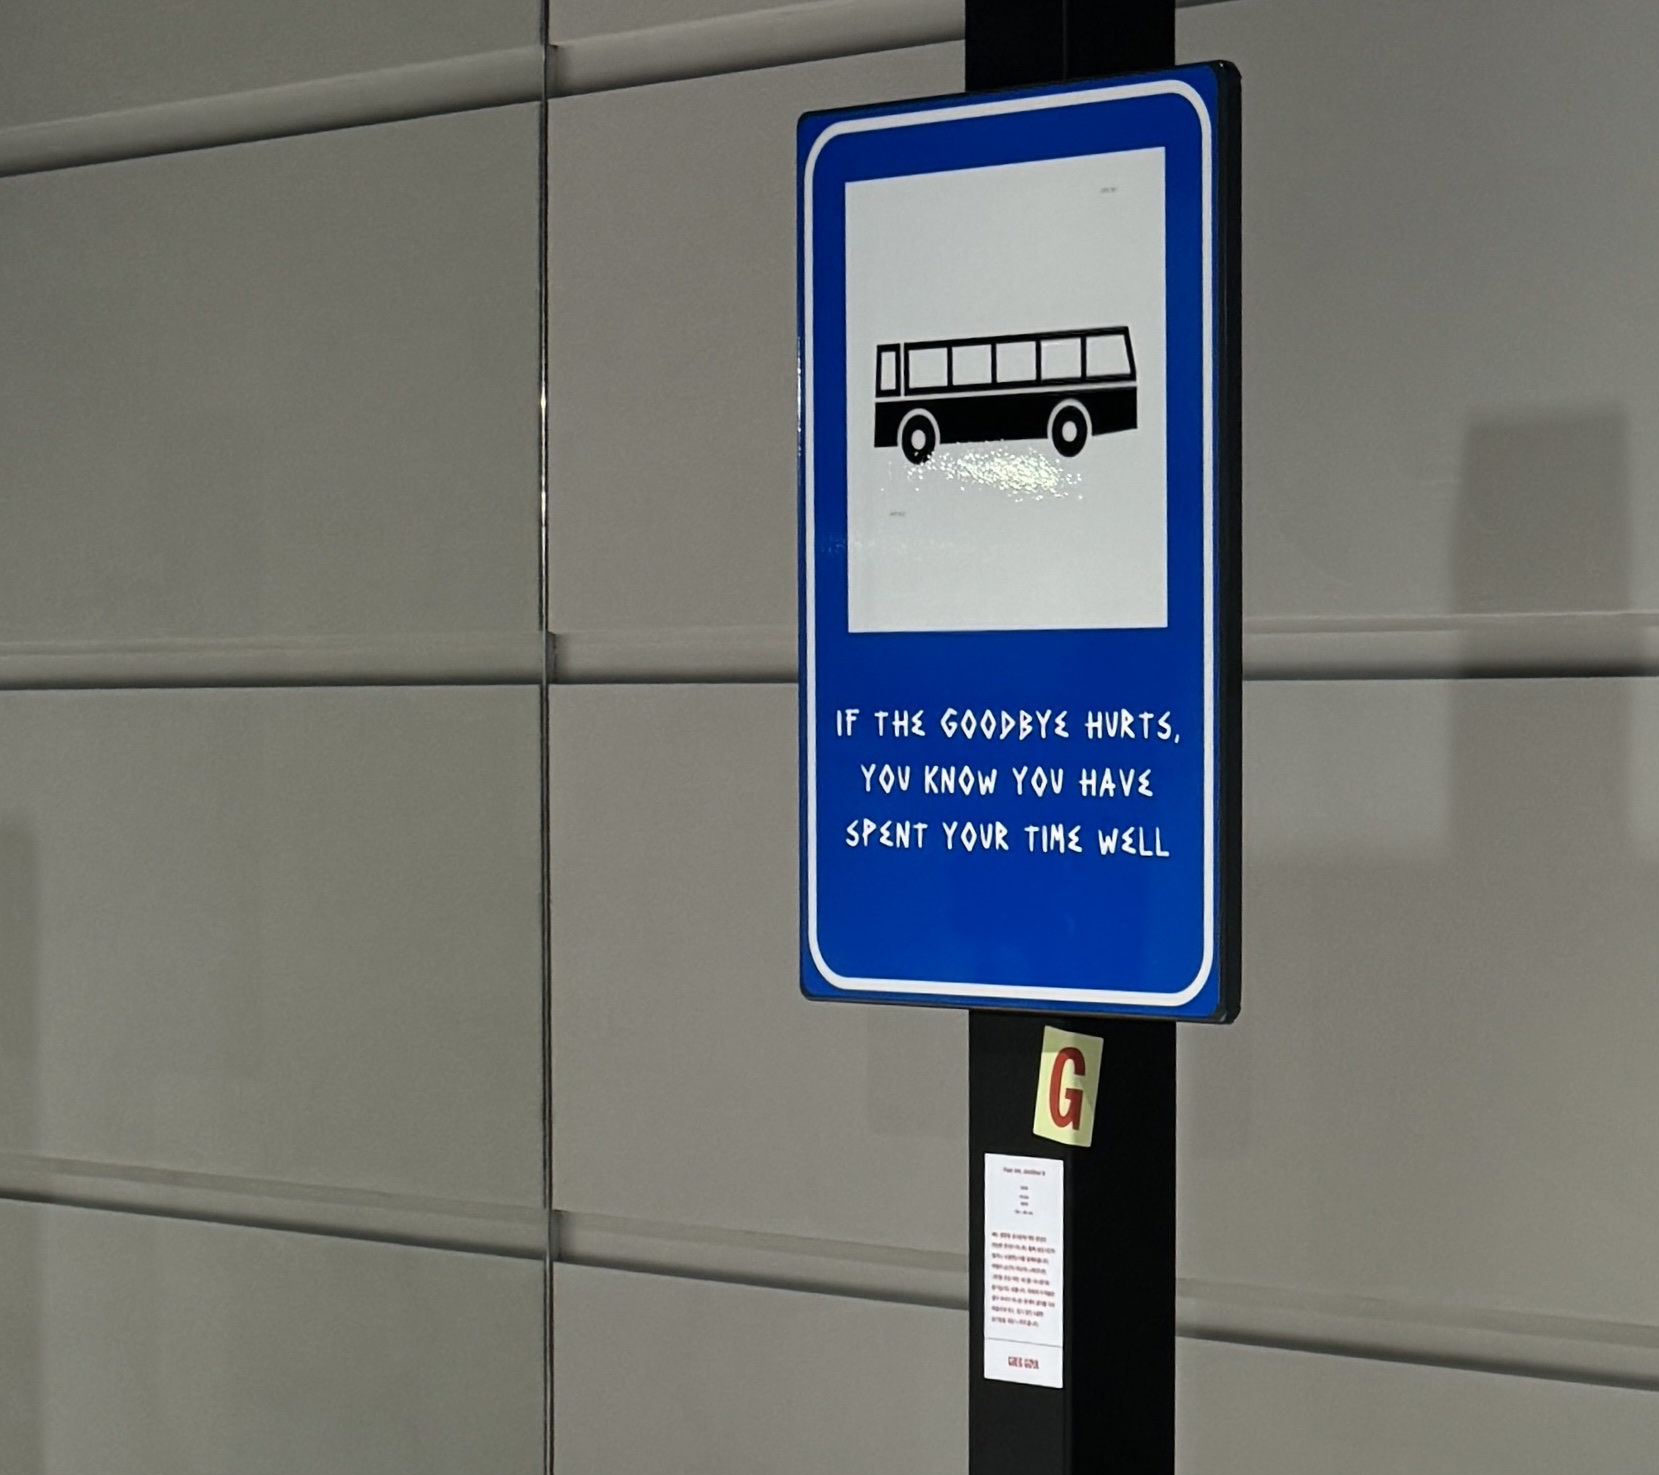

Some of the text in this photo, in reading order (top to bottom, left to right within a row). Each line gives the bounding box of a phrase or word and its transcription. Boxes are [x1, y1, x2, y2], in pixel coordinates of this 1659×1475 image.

[836, 707, 1181, 744] IF THE GOODBYE HURTS,
[861, 763, 1153, 797] YOU KNOW YOU HAVE
[845, 818, 1170, 857] SPENT YOUR TIME WELL
[1049, 1047, 1085, 1130] G
